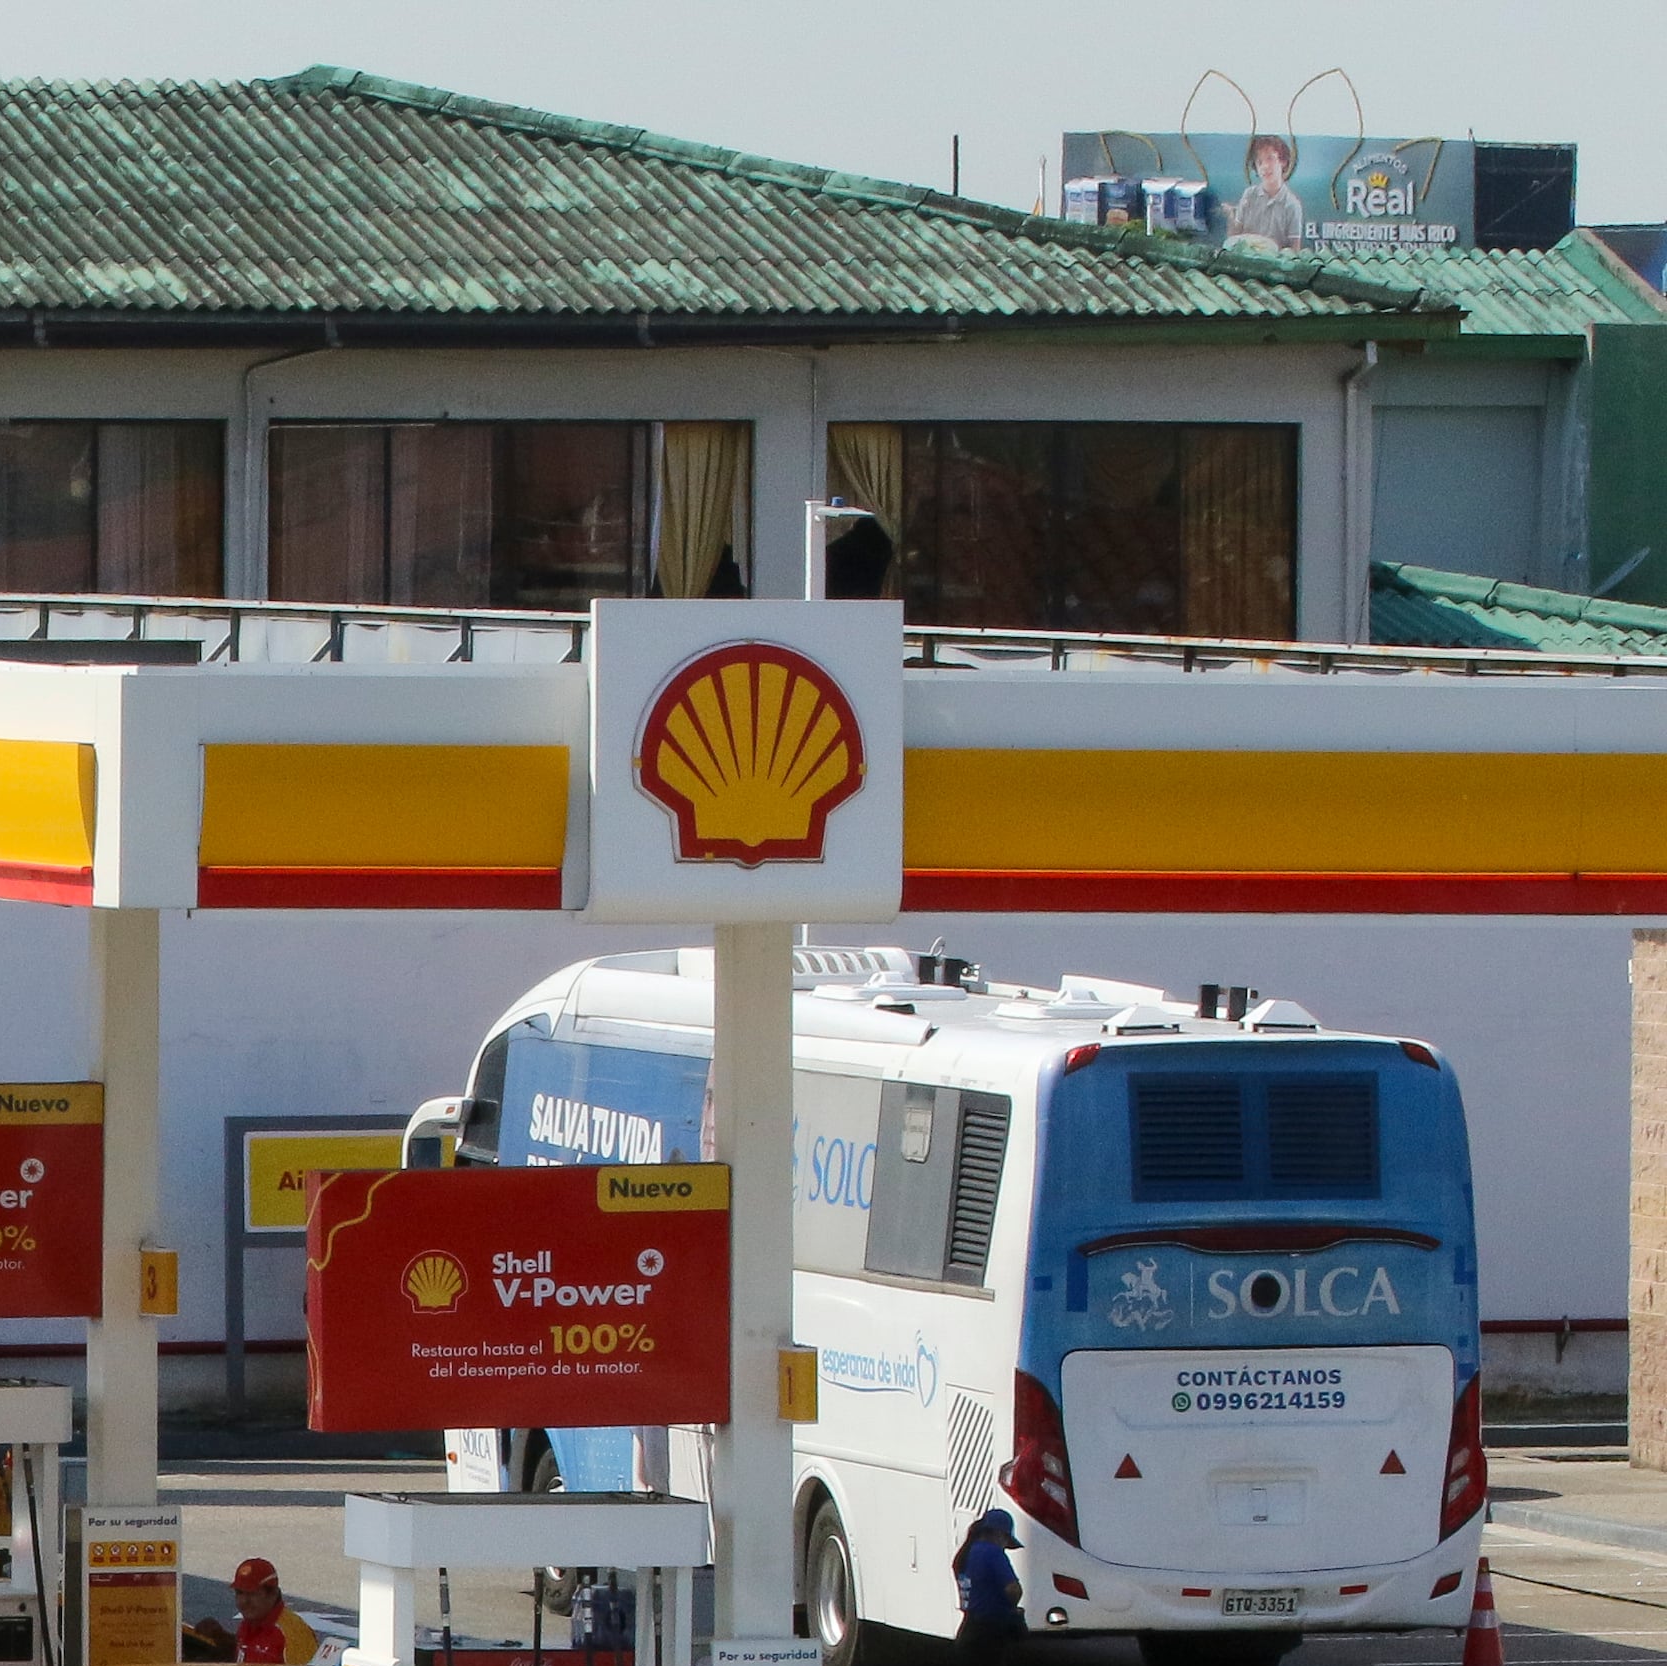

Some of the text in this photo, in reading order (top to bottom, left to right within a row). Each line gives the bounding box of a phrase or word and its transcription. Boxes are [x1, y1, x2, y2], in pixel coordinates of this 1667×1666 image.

[1346, 177, 1414, 218] Real
[529, 1093, 662, 1165] SALVA TU VIDA
[609, 1178, 692, 1199] Nuevo
[492, 1251, 551, 1274] Shell
[146, 1265, 157, 1299] 3
[493, 1279, 651, 1307] V-Power
[411, 1324, 655, 1357] Restaura hasta el 100%
[429, 1362, 643, 1380] del desempeño de tu motor.
[821, 1347, 916, 1388] esperanza de vida
[1177, 1366, 1342, 1387] CONTÁCTANOS
[786, 1366, 793, 1405] 1
[1196, 1391, 1346, 1411] 0996214159
[88, 1517, 106, 1527] Por
[124, 1516, 178, 1529] seguridad
[1224, 1597, 1296, 1613] GTQ-3351
[719, 1651, 738, 1661] Por
[759, 1649, 817, 1663] seguridad
